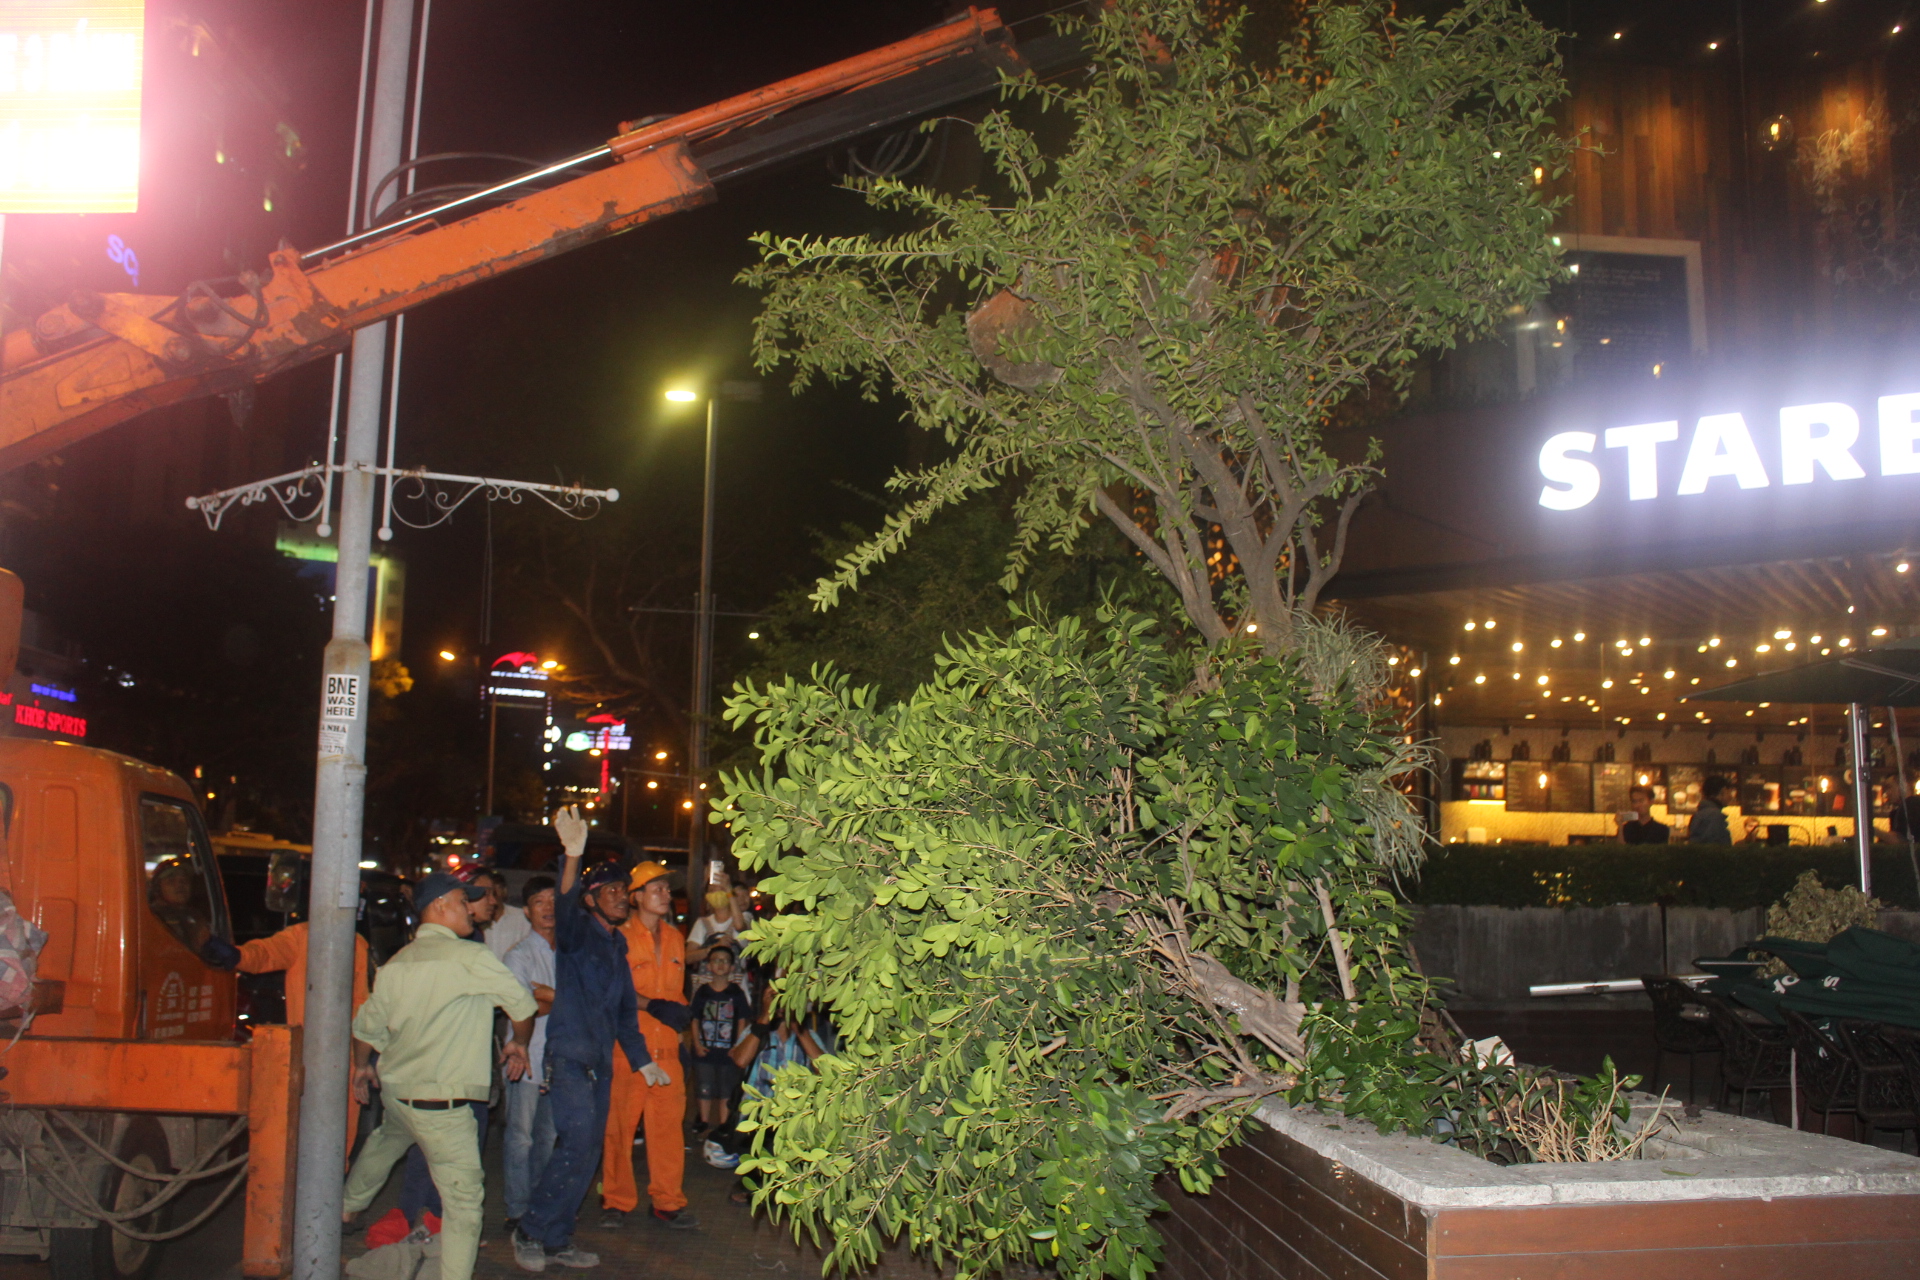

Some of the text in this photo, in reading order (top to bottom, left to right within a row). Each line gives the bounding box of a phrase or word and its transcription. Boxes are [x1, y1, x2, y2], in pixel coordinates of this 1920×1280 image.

[327, 677, 357, 695] BNE
[327, 696, 356, 706] WAS
[326, 706, 355, 717] HERE
[46, 711, 87, 737] SPORTS
